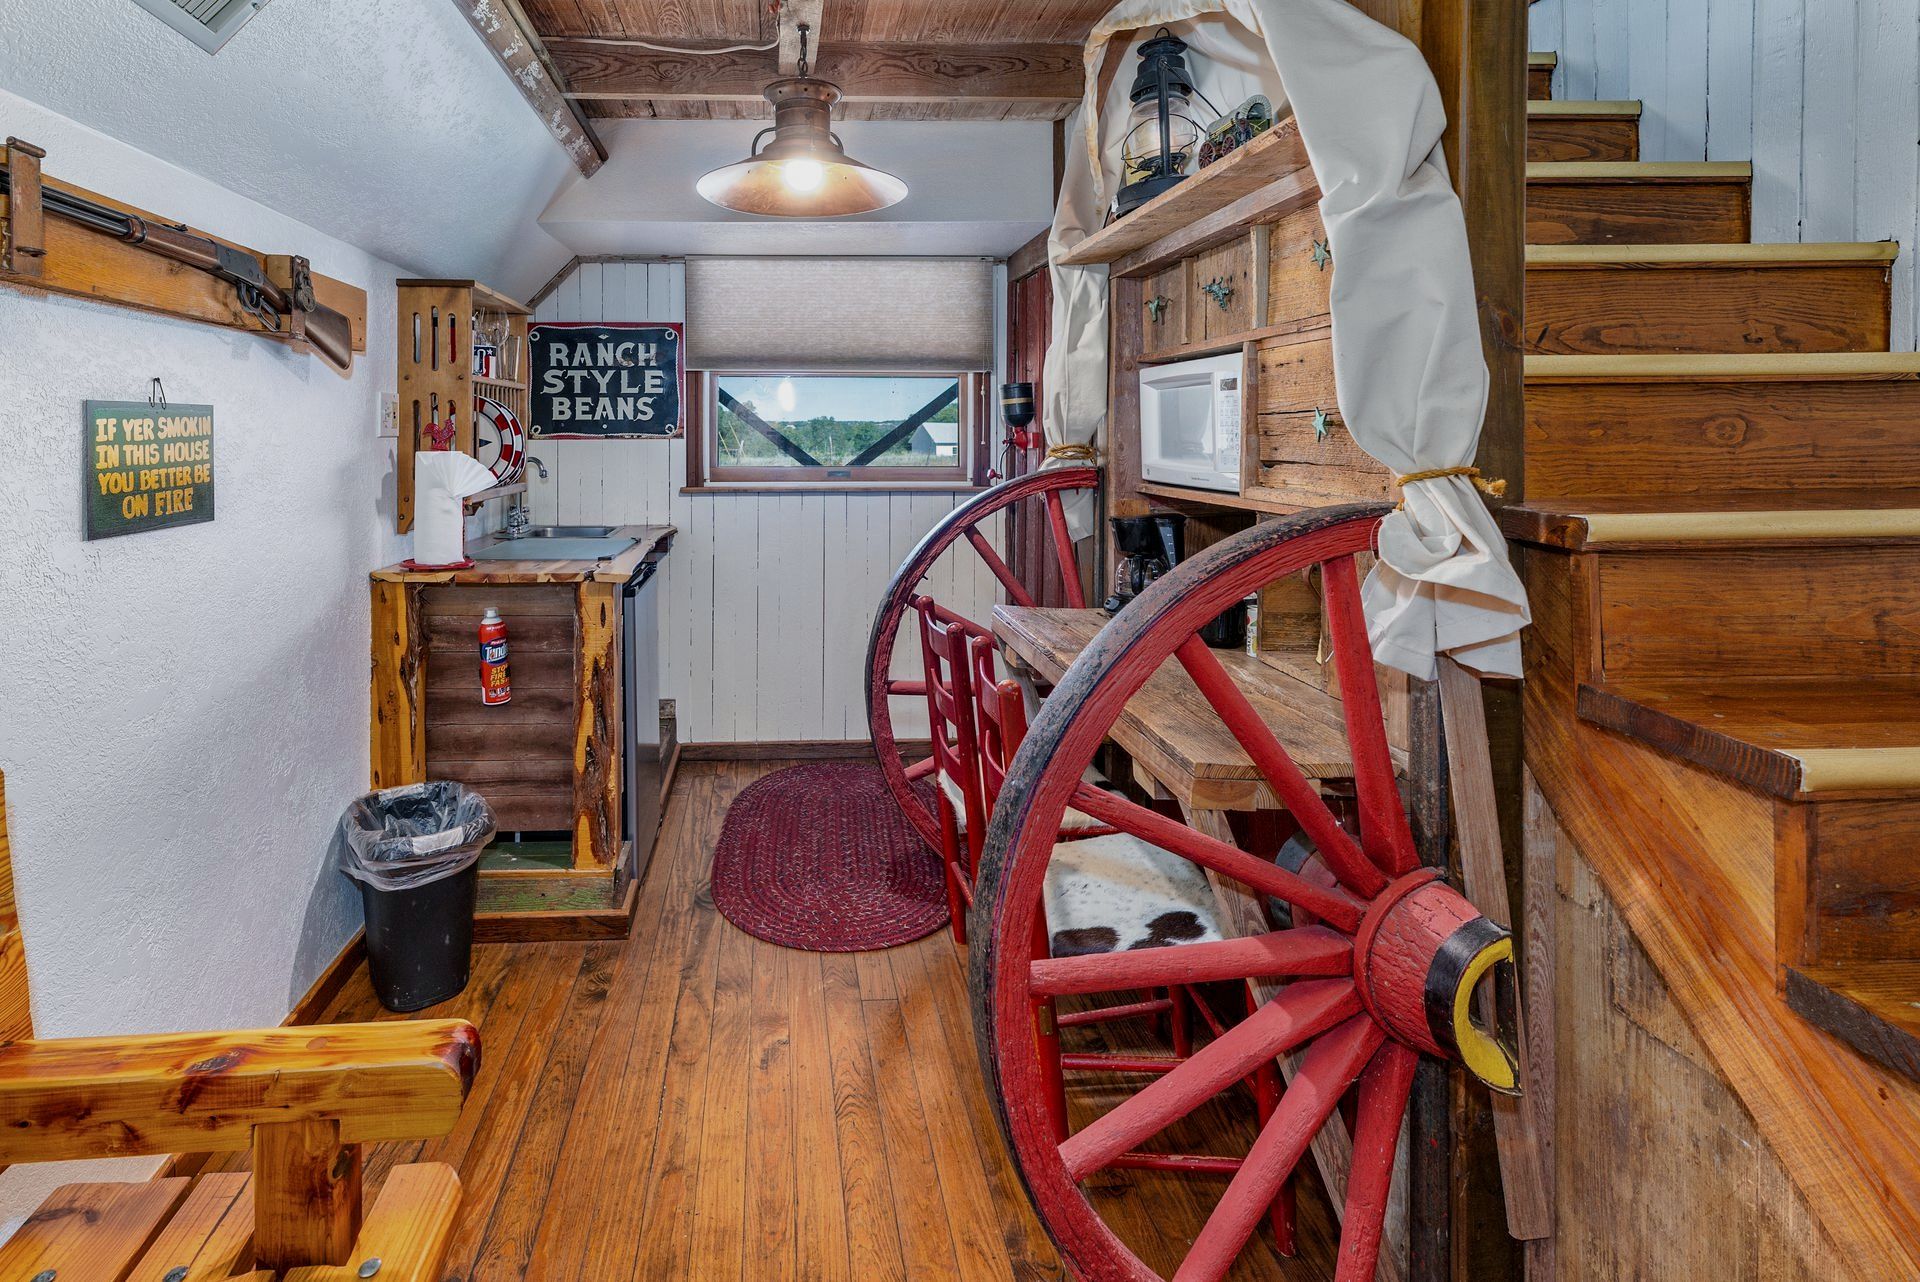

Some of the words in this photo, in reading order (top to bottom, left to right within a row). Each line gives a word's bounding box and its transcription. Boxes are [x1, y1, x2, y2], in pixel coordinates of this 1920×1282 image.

[549, 342, 657, 367] RANCH
[540, 369, 665, 395] STYLE
[552, 396, 657, 422] BEANS
[95, 418, 117, 442] IF
[122, 418, 155, 442] YER
[157, 415, 212, 440] SMOKIN
[96, 444, 119, 470] IN
[123, 444, 159, 467] THIS
[163, 440, 210, 463] HOUSE
[98, 471, 134, 495] YOU
[140, 465, 192, 489] BETTER
[194, 464, 211, 484] BE
[122, 493, 149, 520] ON
[154, 487, 194, 516] FIRE
